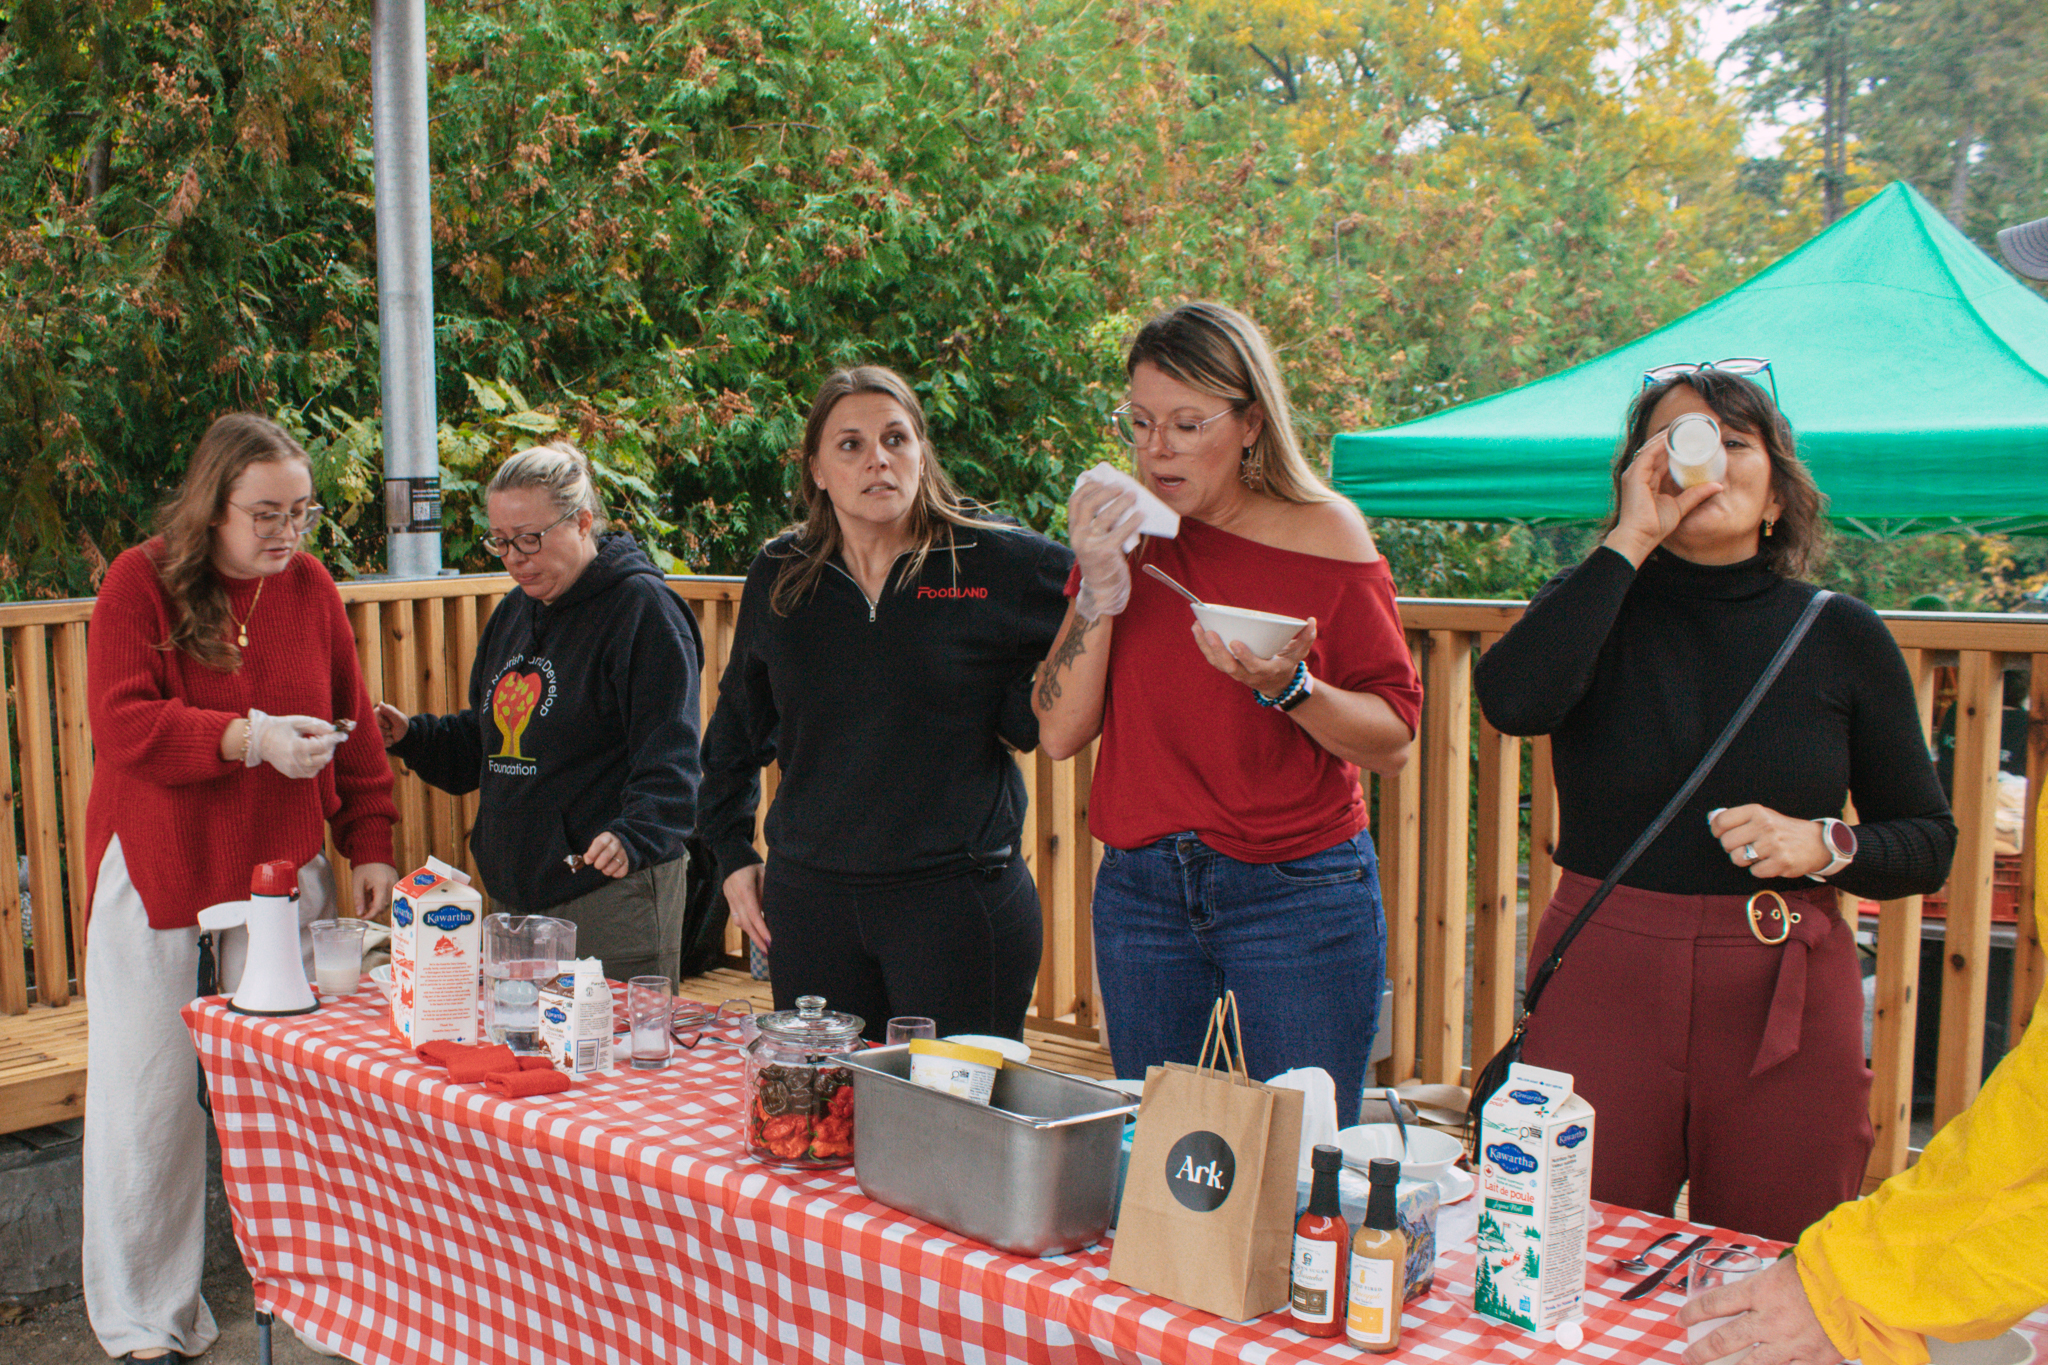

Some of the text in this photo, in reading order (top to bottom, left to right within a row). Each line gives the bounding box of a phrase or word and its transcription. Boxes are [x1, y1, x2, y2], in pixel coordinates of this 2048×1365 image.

[917, 586, 988, 599] FOODLAND
[540, 660, 557, 717] Develop
[427, 912, 472, 924] Kawartha
[1512, 1091, 1547, 1104] Kawartha
[1558, 1130, 1587, 1144] Kawartha
[1489, 1147, 1536, 1169] Kawartha
[1174, 1154, 1225, 1190] Ark.
[1485, 1179, 1499, 1193] Lait
[1500, 1187, 1509, 1197] de
[1510, 1190, 1535, 1204] poule
